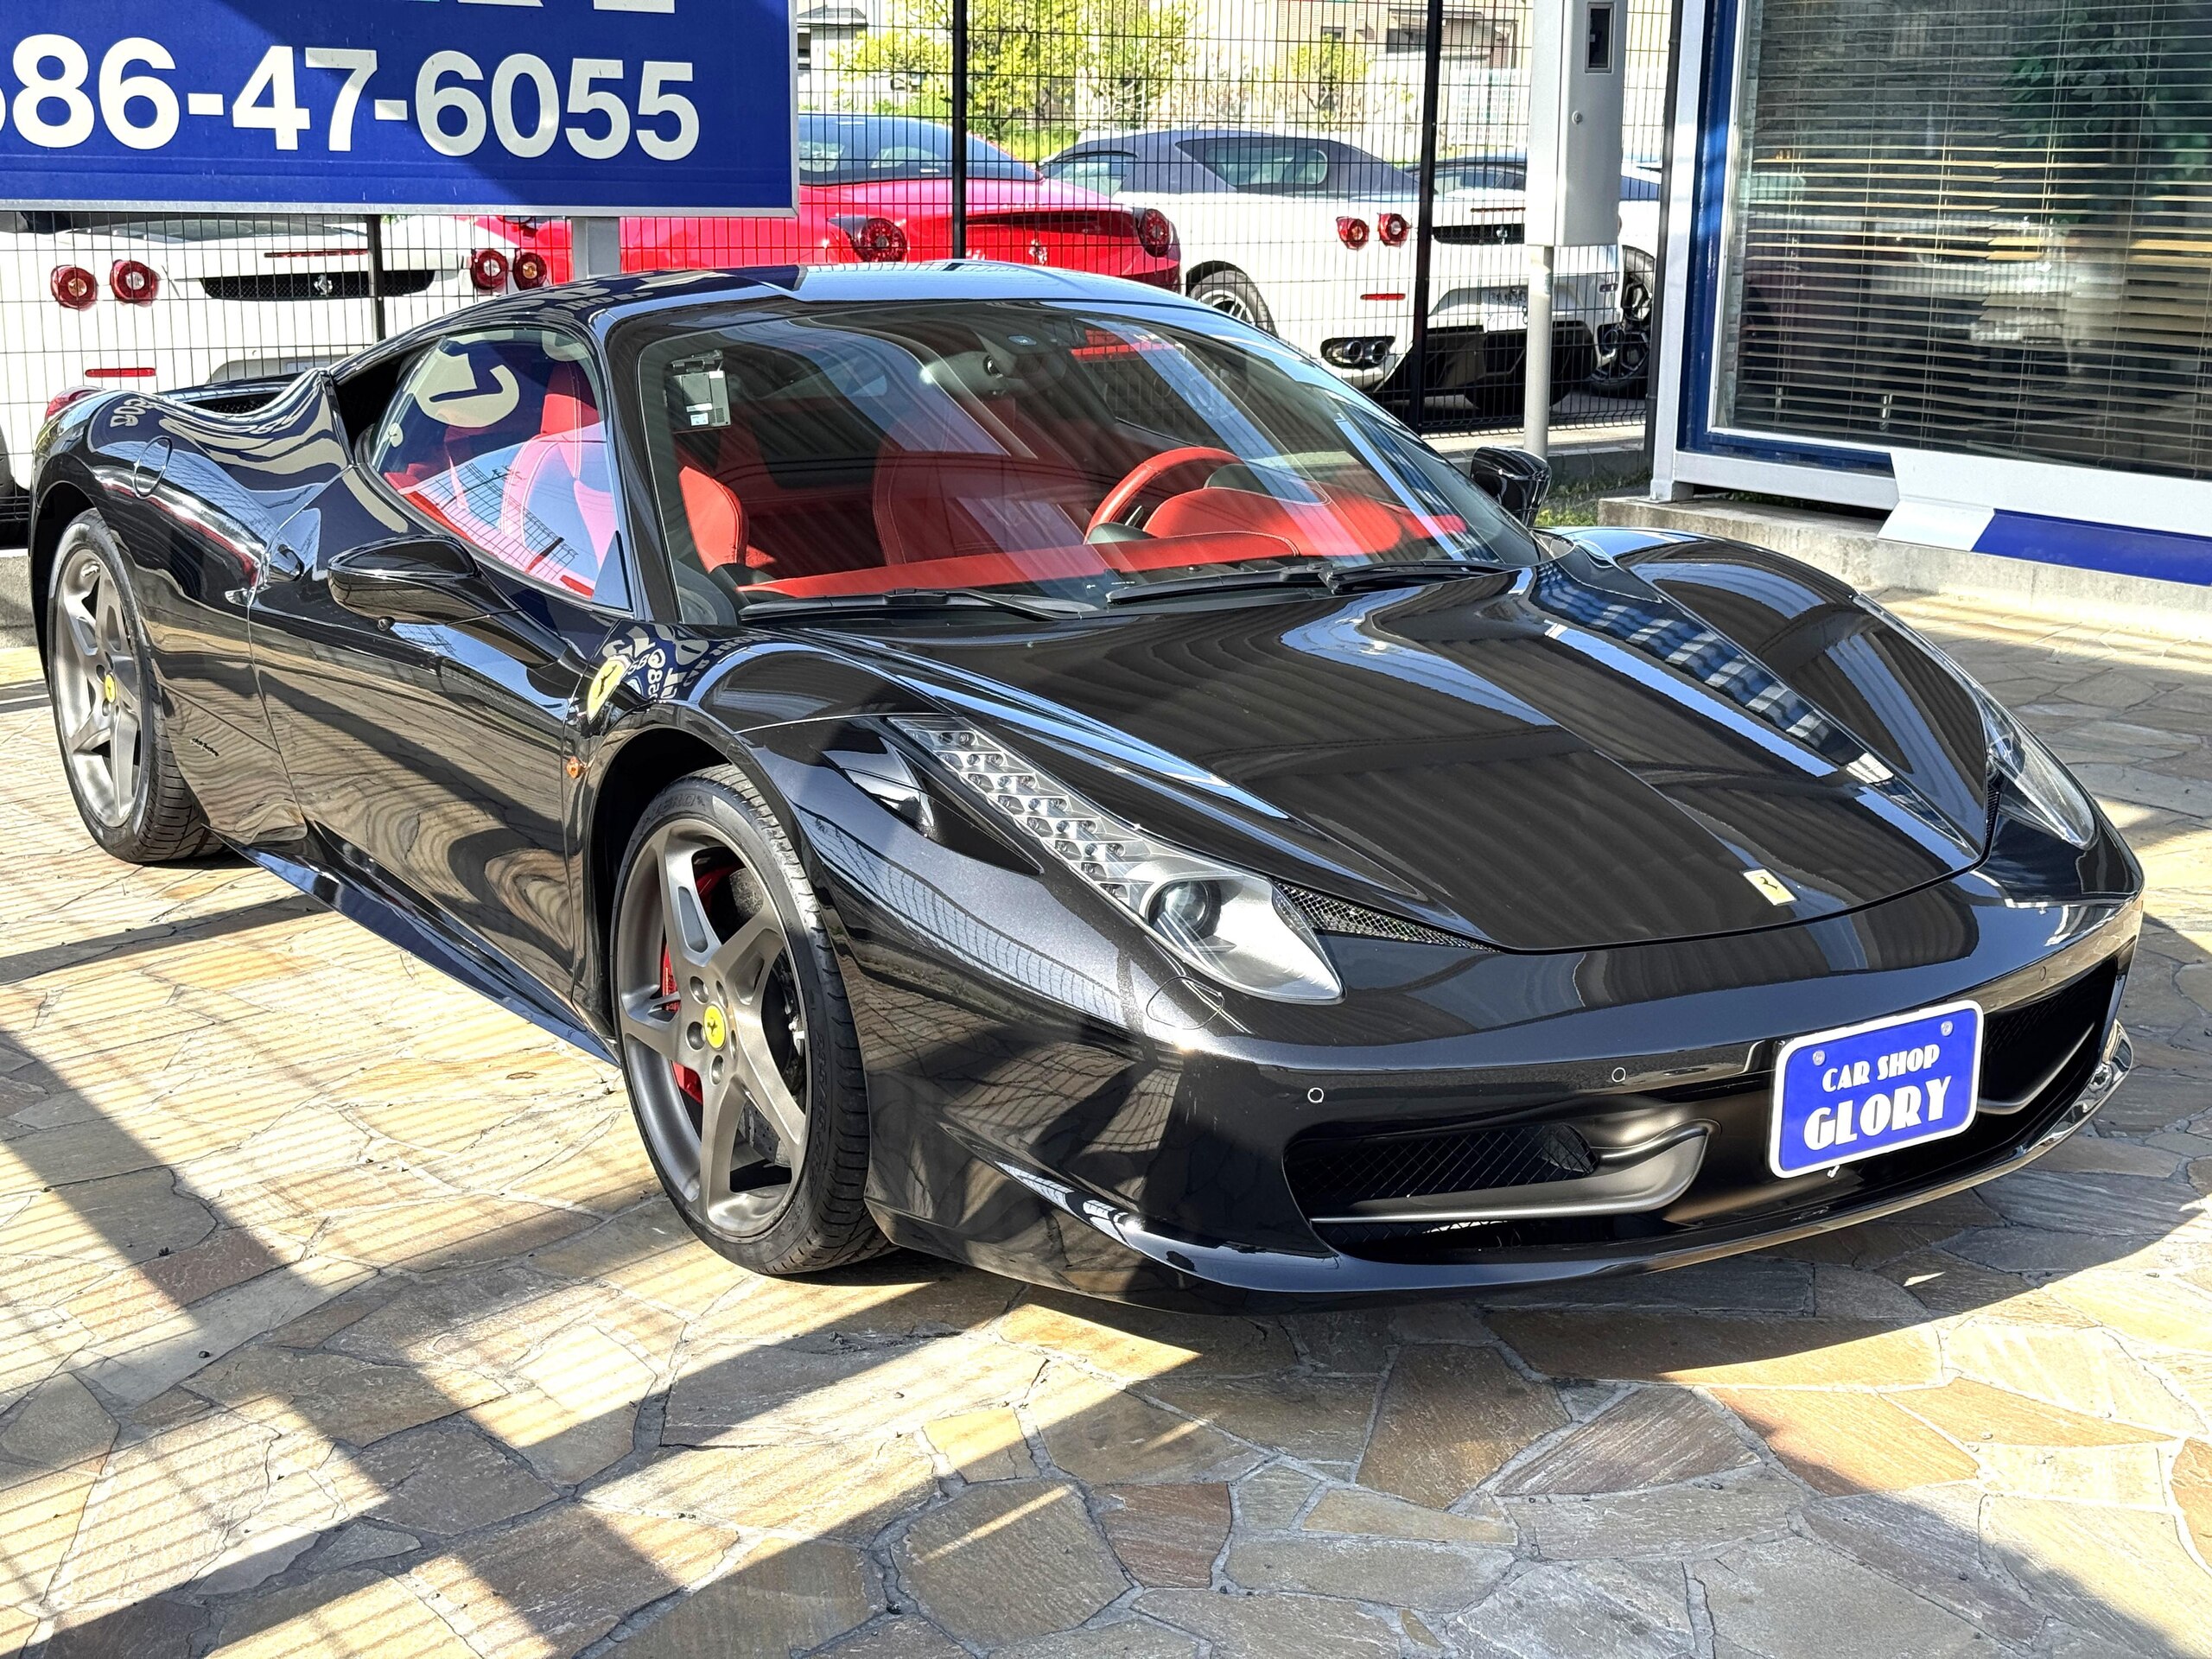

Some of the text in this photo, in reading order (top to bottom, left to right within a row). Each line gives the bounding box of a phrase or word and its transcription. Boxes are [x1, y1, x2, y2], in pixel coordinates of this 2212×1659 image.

[0, 33, 700, 162] 86-47-6055
[1821, 1043, 1941, 1093] CAR SHOP
[1802, 1075, 1953, 1152] GLORY
